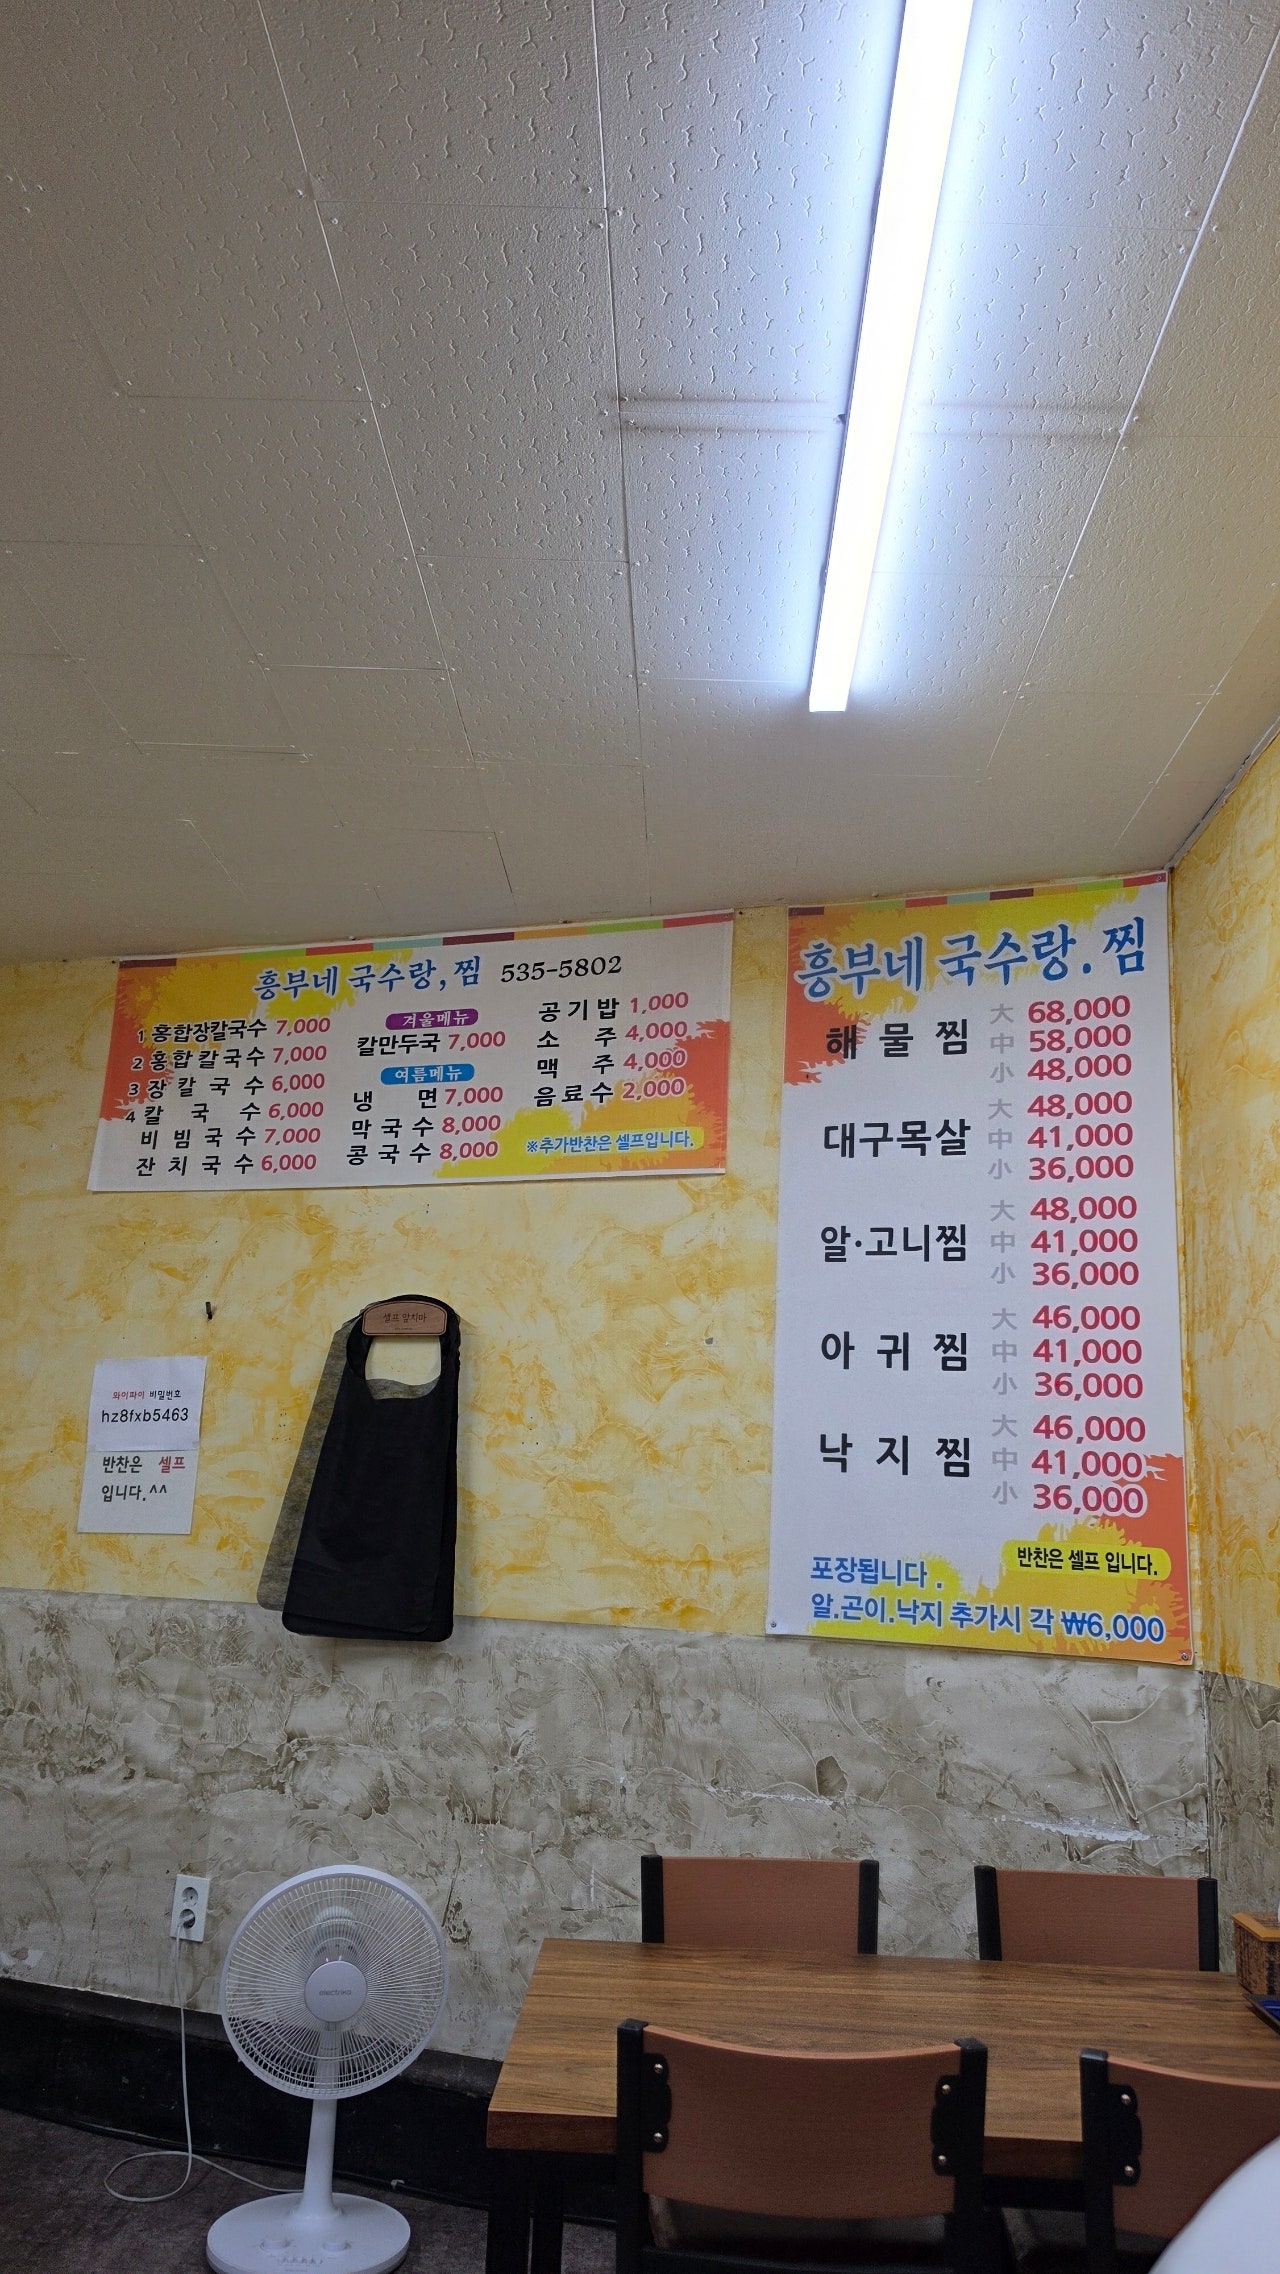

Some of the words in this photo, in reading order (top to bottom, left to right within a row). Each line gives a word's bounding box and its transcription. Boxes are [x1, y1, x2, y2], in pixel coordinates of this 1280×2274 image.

[254, 966, 338, 1000] 흥부네
[500, 955, 622, 983] 535-5802
[797, 935, 924, 999] 흥부네
[629, 991, 689, 1015] 1,000
[990, 1002, 1014, 1025] 大
[1027, 994, 1131, 1026] 68,000
[151, 1018, 268, 1043] 홍합장칼국수
[275, 1017, 331, 1037] 7,000
[402, 1011, 469, 1028] 겨울메뉴
[624, 1021, 688, 1044] 4,000
[357, 1033, 441, 1057] 칼만두국
[448, 1031, 506, 1051] 7,000
[990, 1033, 1015, 1055] 中
[1029, 1023, 1132, 1054] 58,000
[132, 1057, 142, 1070] 2
[272, 1045, 327, 1064] 7,000
[623, 1049, 687, 1073] 4,000
[989, 1062, 1015, 1084] 小
[1027, 1053, 1132, 1083] 48,000
[128, 1083, 139, 1096] 3
[271, 1073, 325, 1093] 6,000
[395, 1066, 462, 1083] 여름메뉴
[444, 1086, 503, 1107] 7,000
[622, 1078, 685, 1100] 2,000
[125, 1111, 136, 1123] 4
[267, 1101, 324, 1121] 6,000
[988, 1098, 1013, 1120] 大
[1027, 1090, 1133, 1121] 48,000
[263, 1127, 321, 1145] 7,000
[441, 1115, 501, 1135] 8,000
[988, 1128, 1013, 1150] 中
[1027, 1123, 1134, 1152] 41,000
[439, 1141, 499, 1161] 8,000
[615, 1130, 694, 1151] 셀프입니다.
[823, 1118, 971, 1159] 대구목살
[261, 1154, 317, 1174] 6,000
[988, 1157, 1014, 1180] 小
[1028, 1154, 1135, 1183] 36,000
[989, 1200, 1016, 1222] 大
[1029, 1195, 1138, 1224] 48,000
[990, 1231, 1016, 1254] 中
[1030, 1228, 1138, 1257] 41,000
[990, 1262, 1016, 1285] 小
[1032, 1261, 1140, 1290] 36,000
[383, 1312, 399, 1324] 셀프
[402, 1312, 427, 1323] 앞치마
[991, 1308, 1017, 1331] 大
[1032, 1305, 1141, 1334] 46,000
[991, 1339, 1017, 1363] 中
[1032, 1338, 1143, 1367] 41,000
[112, 1390, 145, 1400] 와이파이
[149, 1389, 181, 1400] 비밀번호
[992, 1373, 1018, 1396] 小
[1034, 1371, 1144, 1402] 36,000
[101, 1407, 189, 1423] hz8fxb5463
[991, 1414, 1018, 1438] 大
[1033, 1414, 1146, 1445] 46,000
[103, 1455, 143, 1474] 반찬은
[158, 1456, 186, 1474] 셀프
[991, 1447, 1018, 1472] 中
[1031, 1449, 1143, 1480] 41,000
[992, 1481, 1019, 1505] 小
[1033, 1483, 1144, 1515] 36,000
[1017, 1547, 1064, 1570] 반찬은
[1068, 1550, 1100, 1571] 셀프
[1105, 1552, 1158, 1576] 입니다.
[950, 1602, 1022, 1634] 추가시
[1030, 1607, 1054, 1635] 각
